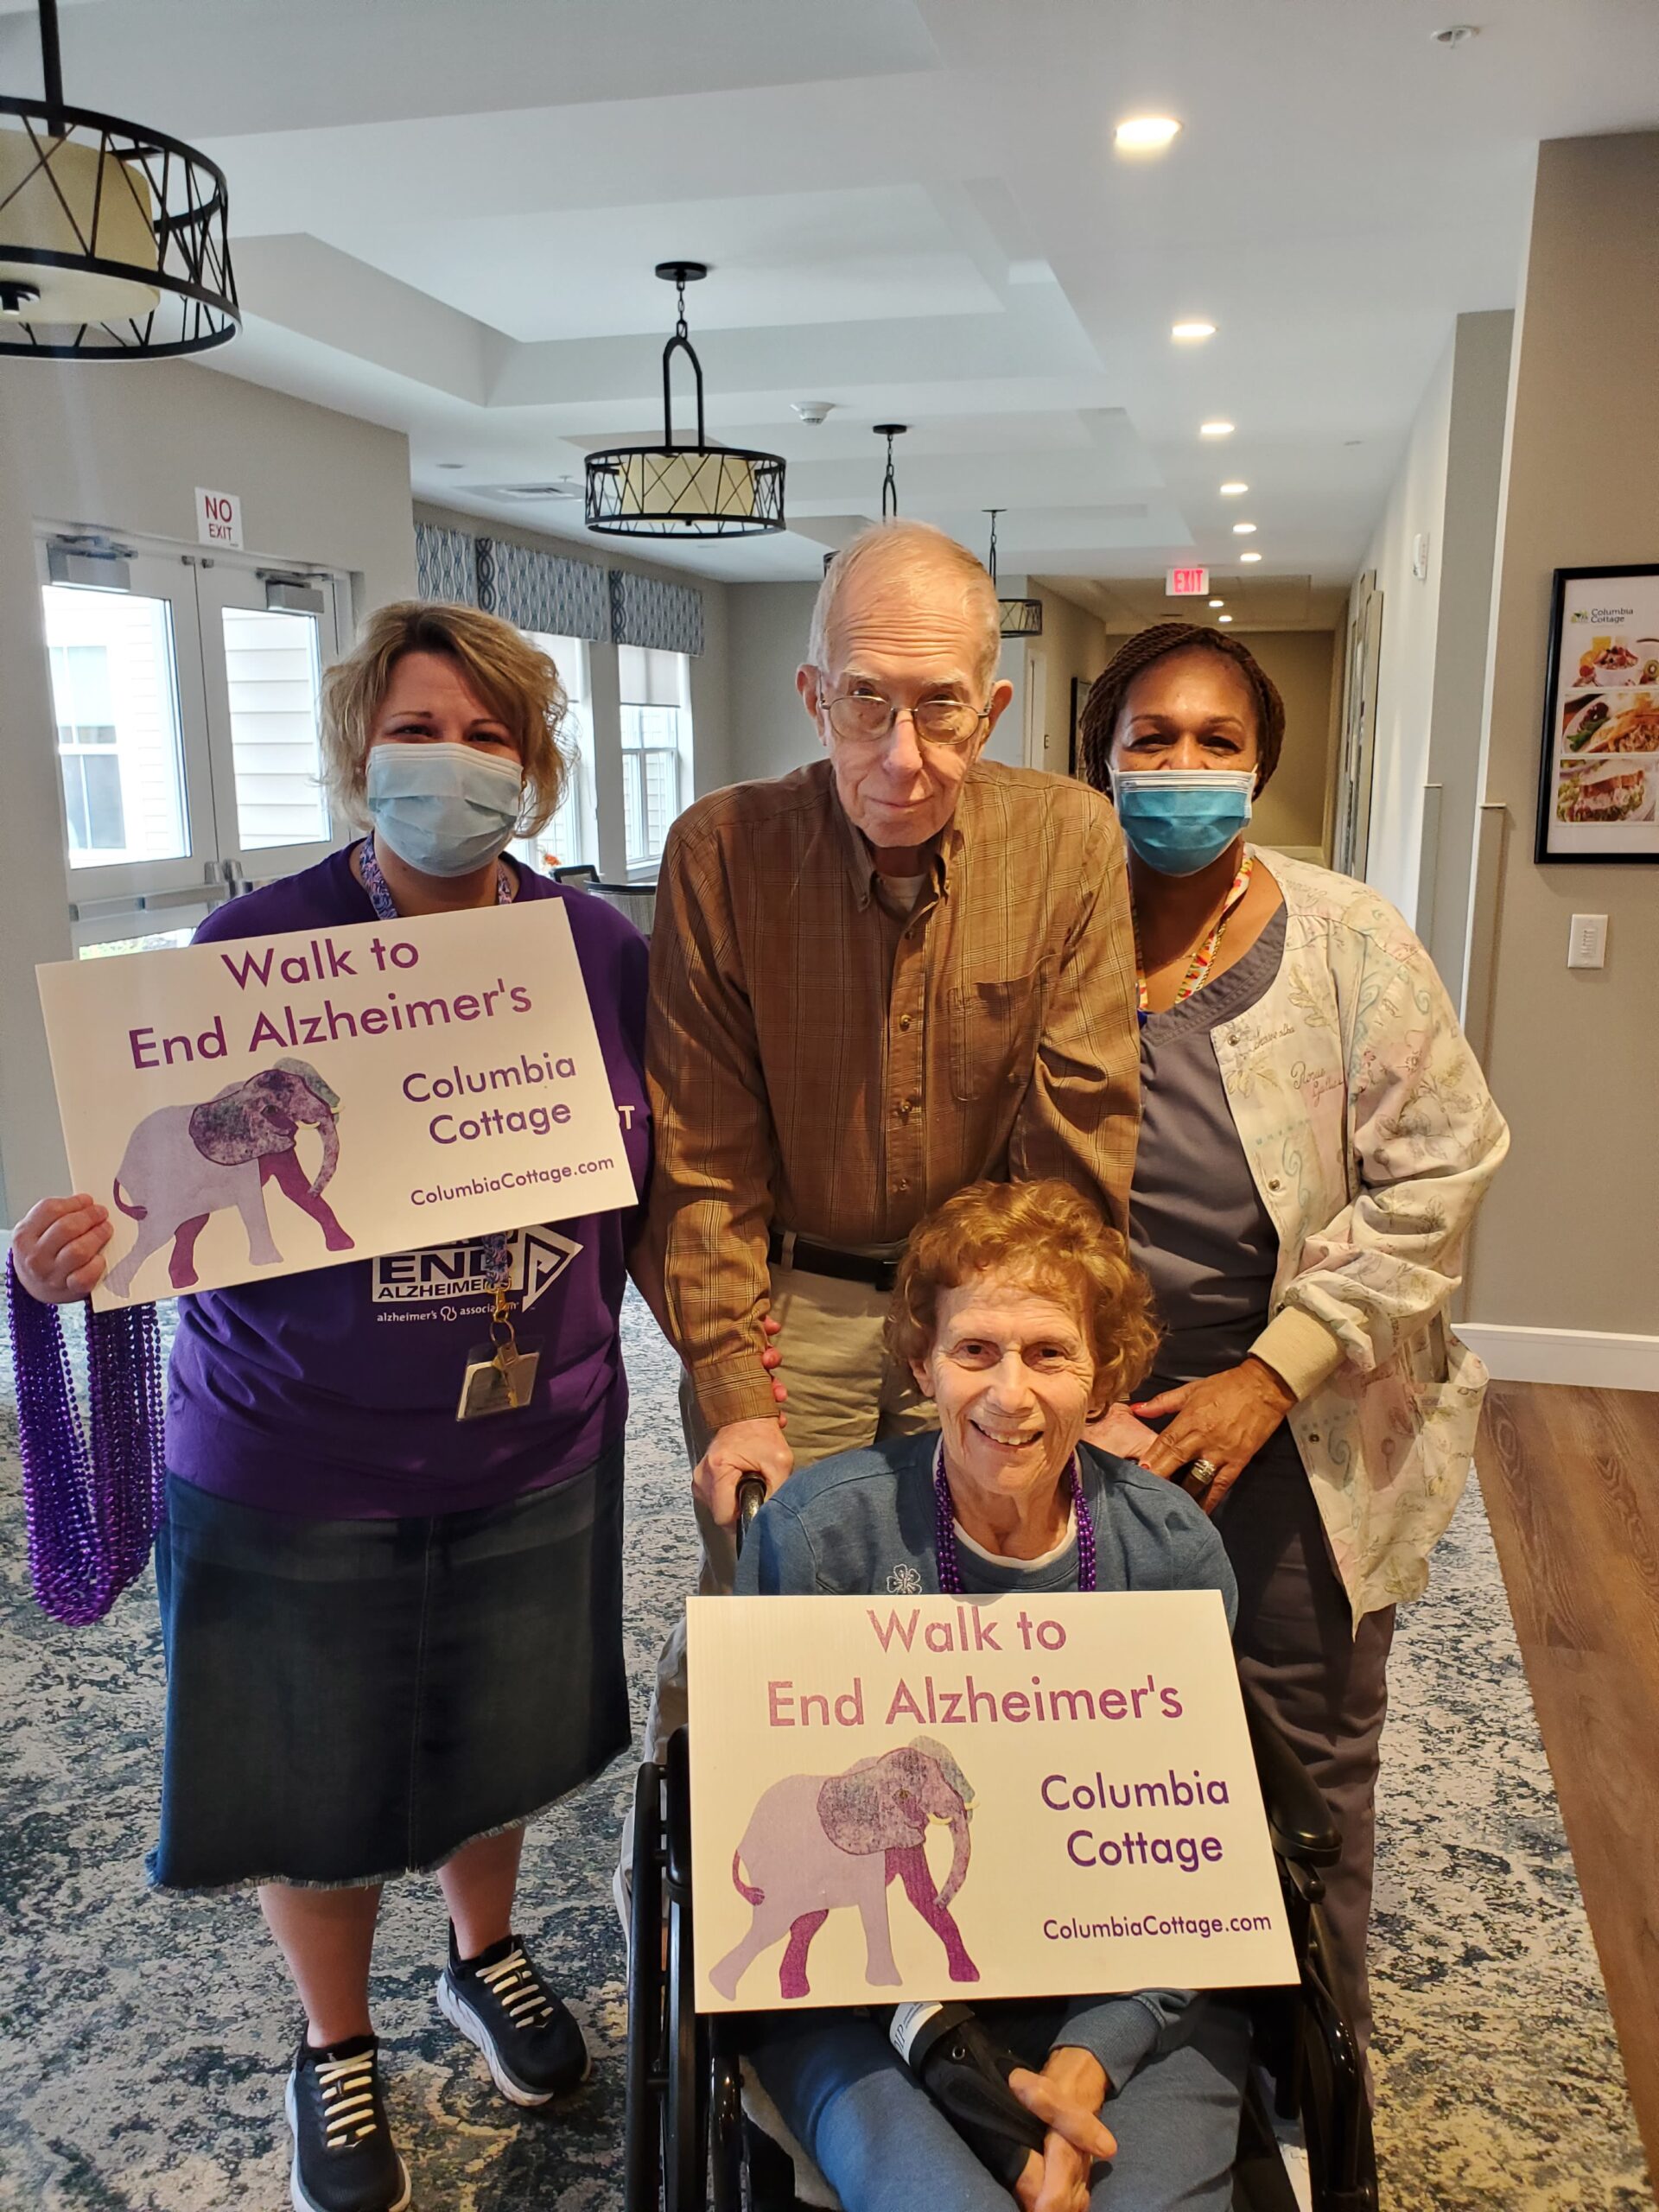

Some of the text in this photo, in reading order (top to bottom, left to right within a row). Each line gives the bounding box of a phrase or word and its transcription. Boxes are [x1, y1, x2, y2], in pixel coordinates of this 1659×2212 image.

[205, 495, 232, 523] NO
[209, 524, 232, 541] EXIT
[1174, 569, 1204, 593] EXIT
[1591, 607, 1634, 616] Columbia
[220, 937, 419, 991] Walk to
[129, 978, 533, 1070] End Alzheimer's
[403, 1052, 576, 1103] Columbia
[429, 1103, 571, 1145] Cottage
[410, 1157, 614, 1206] ColumbiaCottage.com
[378, 1278, 488, 1299] ALZHEIME
[377, 1310, 438, 1322] alzheimer's
[867, 1605, 1066, 1653] Walk to
[768, 1675, 1183, 1726] End Alzheimer's
[1041, 1769, 1230, 1811] Columbia
[1066, 1829, 1224, 1872] Cottage
[1044, 1915, 1272, 1940] ColumbiaCottage.com
